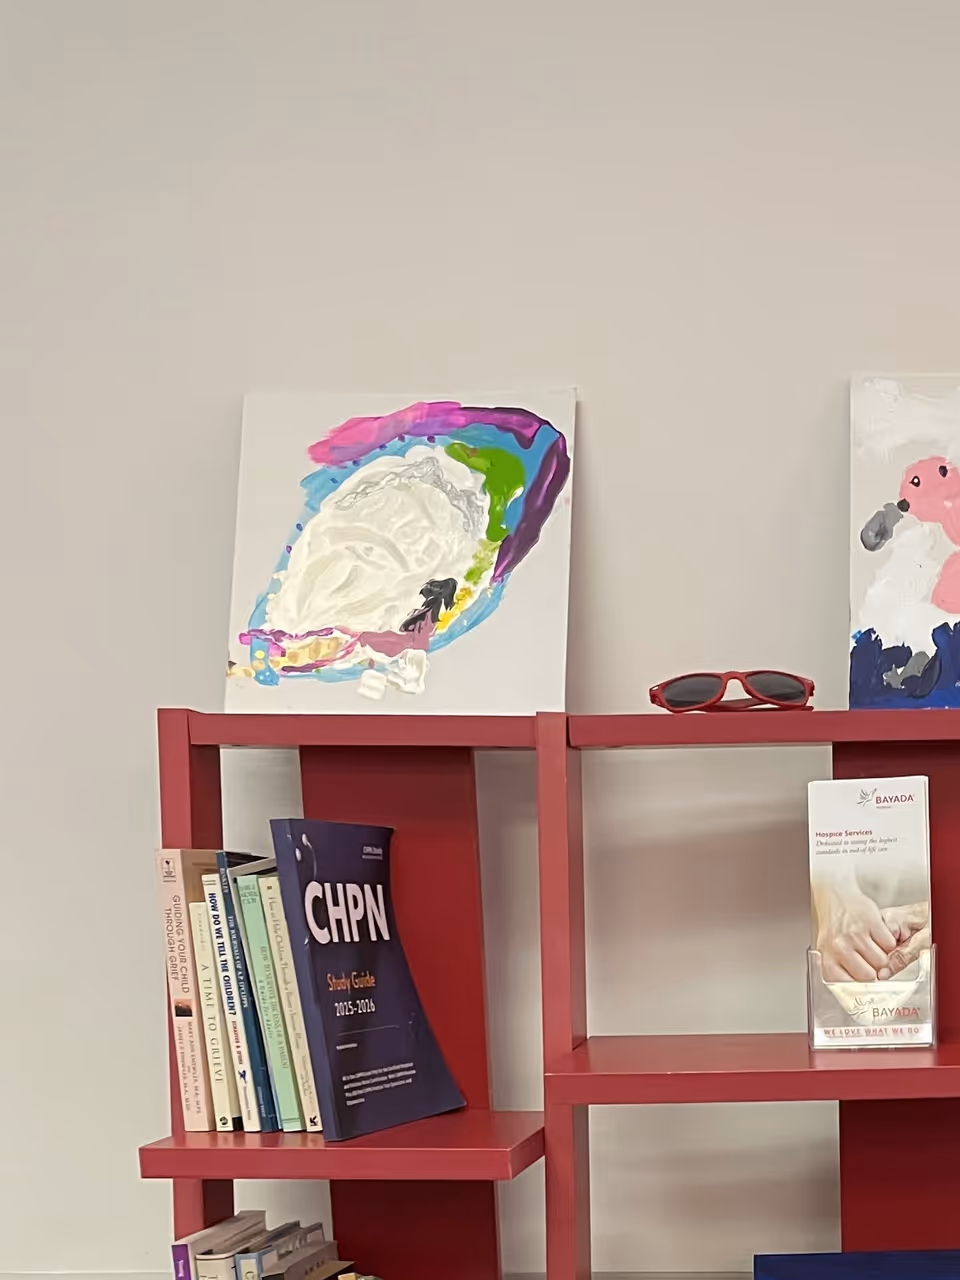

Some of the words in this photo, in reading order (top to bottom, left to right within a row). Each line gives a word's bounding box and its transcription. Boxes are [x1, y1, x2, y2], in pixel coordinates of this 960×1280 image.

[875, 794, 915, 804] BAYADA
[844, 829, 873, 837] Services
[208, 893, 219, 912] HOW
[304, 881, 390, 945] CHPN
[173, 894, 184, 936] GUIDING
[212, 914, 221, 926] DO
[165, 908, 176, 953] THROUGH
[215, 927, 224, 939] WE
[178, 937, 187, 963] YOUR
[217, 942, 227, 958] TELL
[169, 955, 179, 981] GRIEF
[220, 959, 230, 973] THE
[180, 966, 190, 994] CHILD
[327, 971, 350, 995] Study
[351, 970, 376, 989] Guide
[203, 977, 215, 1008] TIME
[223, 975, 237, 1016] CHILDREN?
[334, 998, 376, 1017] 2025-2026
[872, 1007, 919, 1018] BAYADA
[207, 1015, 217, 1032] TO
[210, 1038, 225, 1083] GRIEVE
